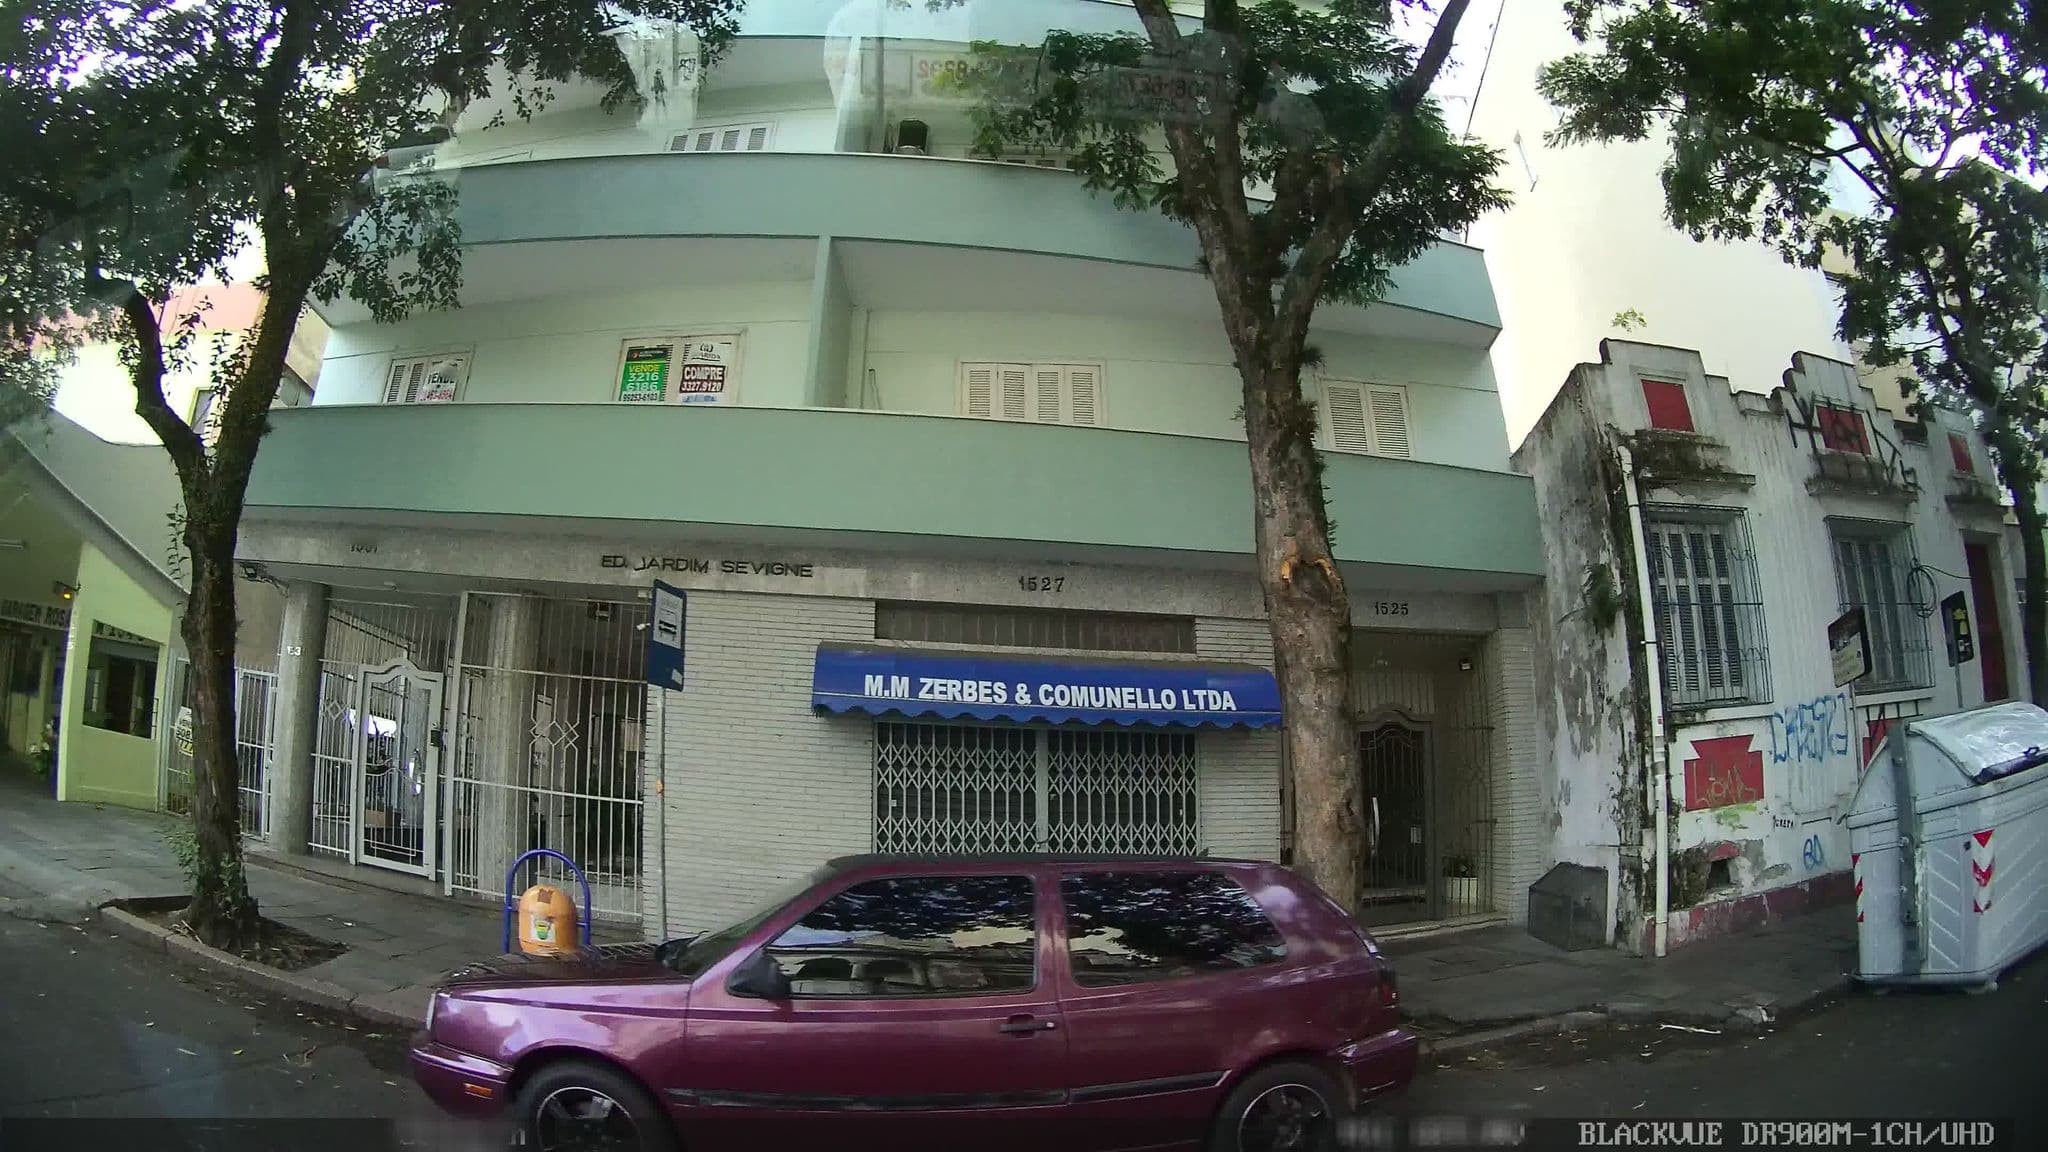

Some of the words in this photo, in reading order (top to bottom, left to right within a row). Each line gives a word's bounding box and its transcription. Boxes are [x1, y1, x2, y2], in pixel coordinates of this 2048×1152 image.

[629, 372, 659, 382] 3216
[684, 367, 723, 380] COMPRE
[626, 382, 658, 392] 6186
[681, 381, 721, 392] 3327.9120
[634, 557, 709, 573] JARDIM
[721, 560, 814, 578] SEVIGNE
[1018, 575, 1066, 593] 1527
[1374, 601, 1409, 616] 1525
[864, 674, 910, 698] M.M
[918, 677, 1007, 705] ZERBES
[1014, 684, 1032, 705] &
[1038, 684, 1177, 711] COMUNELLO
[1182, 689, 1237, 711] LTDA
